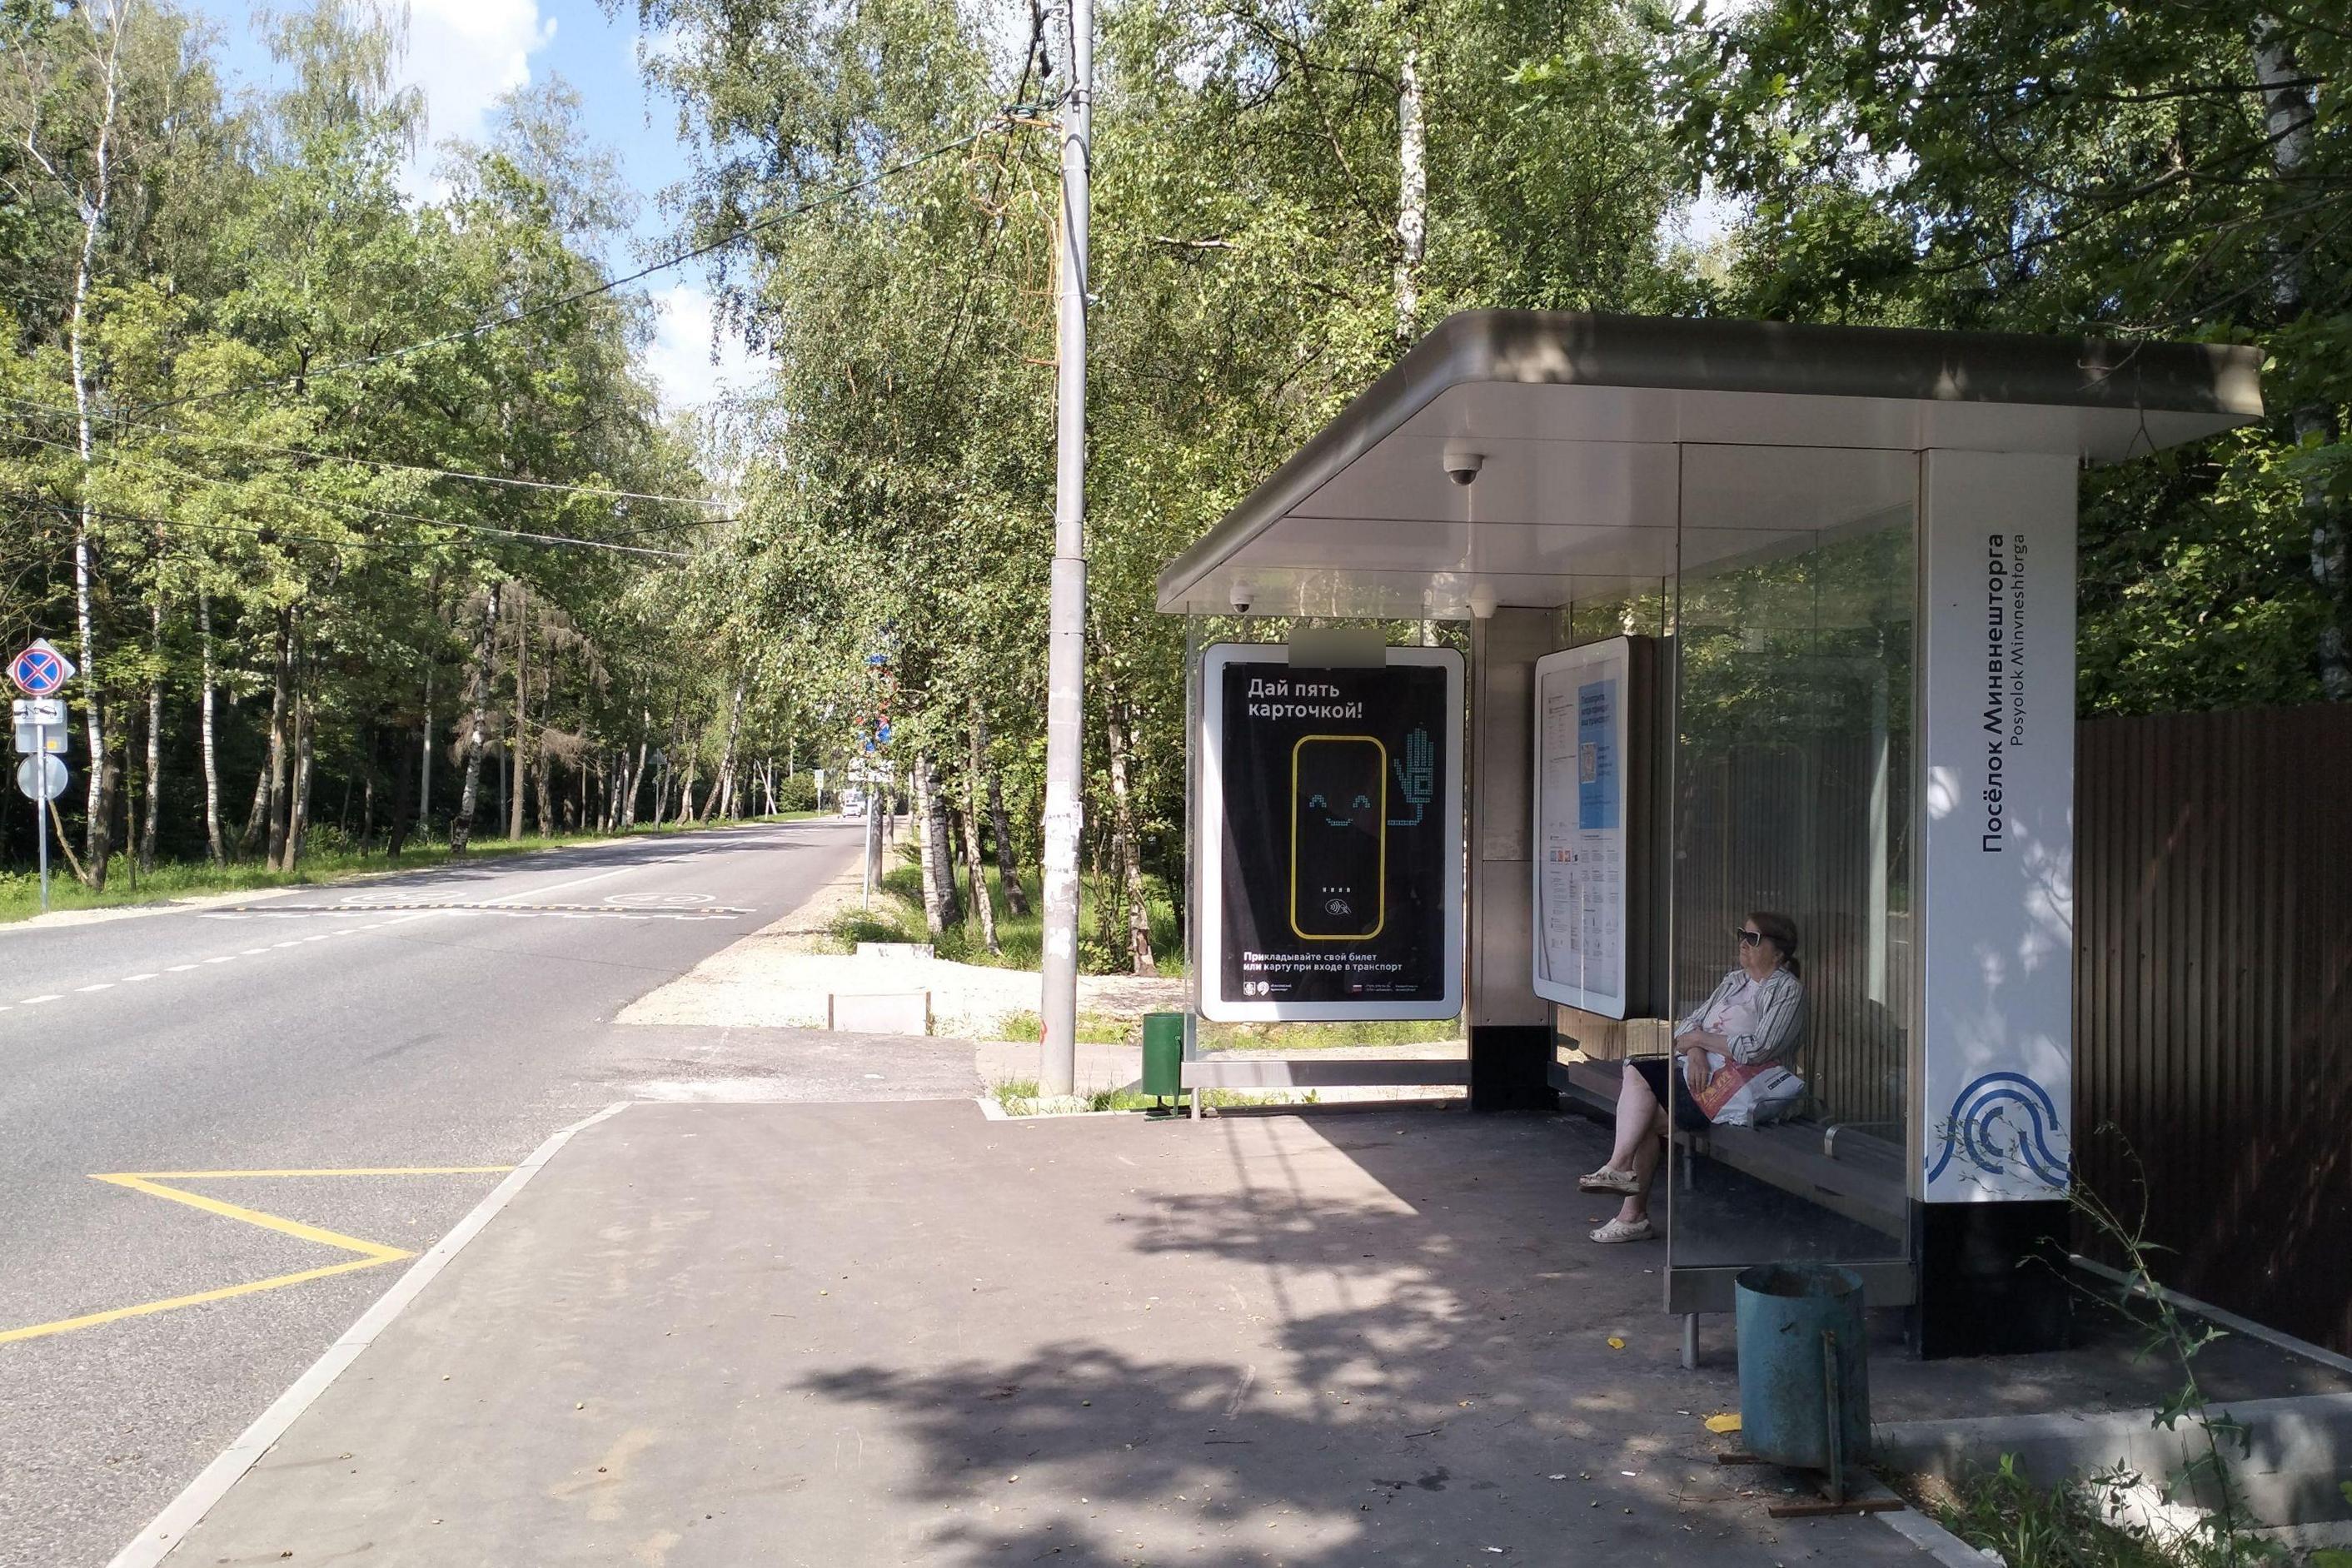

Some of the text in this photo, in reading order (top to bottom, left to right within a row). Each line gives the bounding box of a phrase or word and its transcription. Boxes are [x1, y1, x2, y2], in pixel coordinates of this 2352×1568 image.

[2010, 534, 2028, 746] Posyolok Minvneshtorga
[1248, 678, 1340, 699] Дай пять
[1982, 534, 2008, 853] Посёлок Минвнешторга
[1248, 702, 1363, 721] карточкой!
[1243, 951, 1378, 963] Прикладывайте свой билет
[1243, 963, 1262, 971] или
[1263, 963, 1292, 973] карту
[1293, 963, 1312, 973] при
[1313, 963, 1343, 972] входе
[1353, 963, 1403, 973] транспорт
